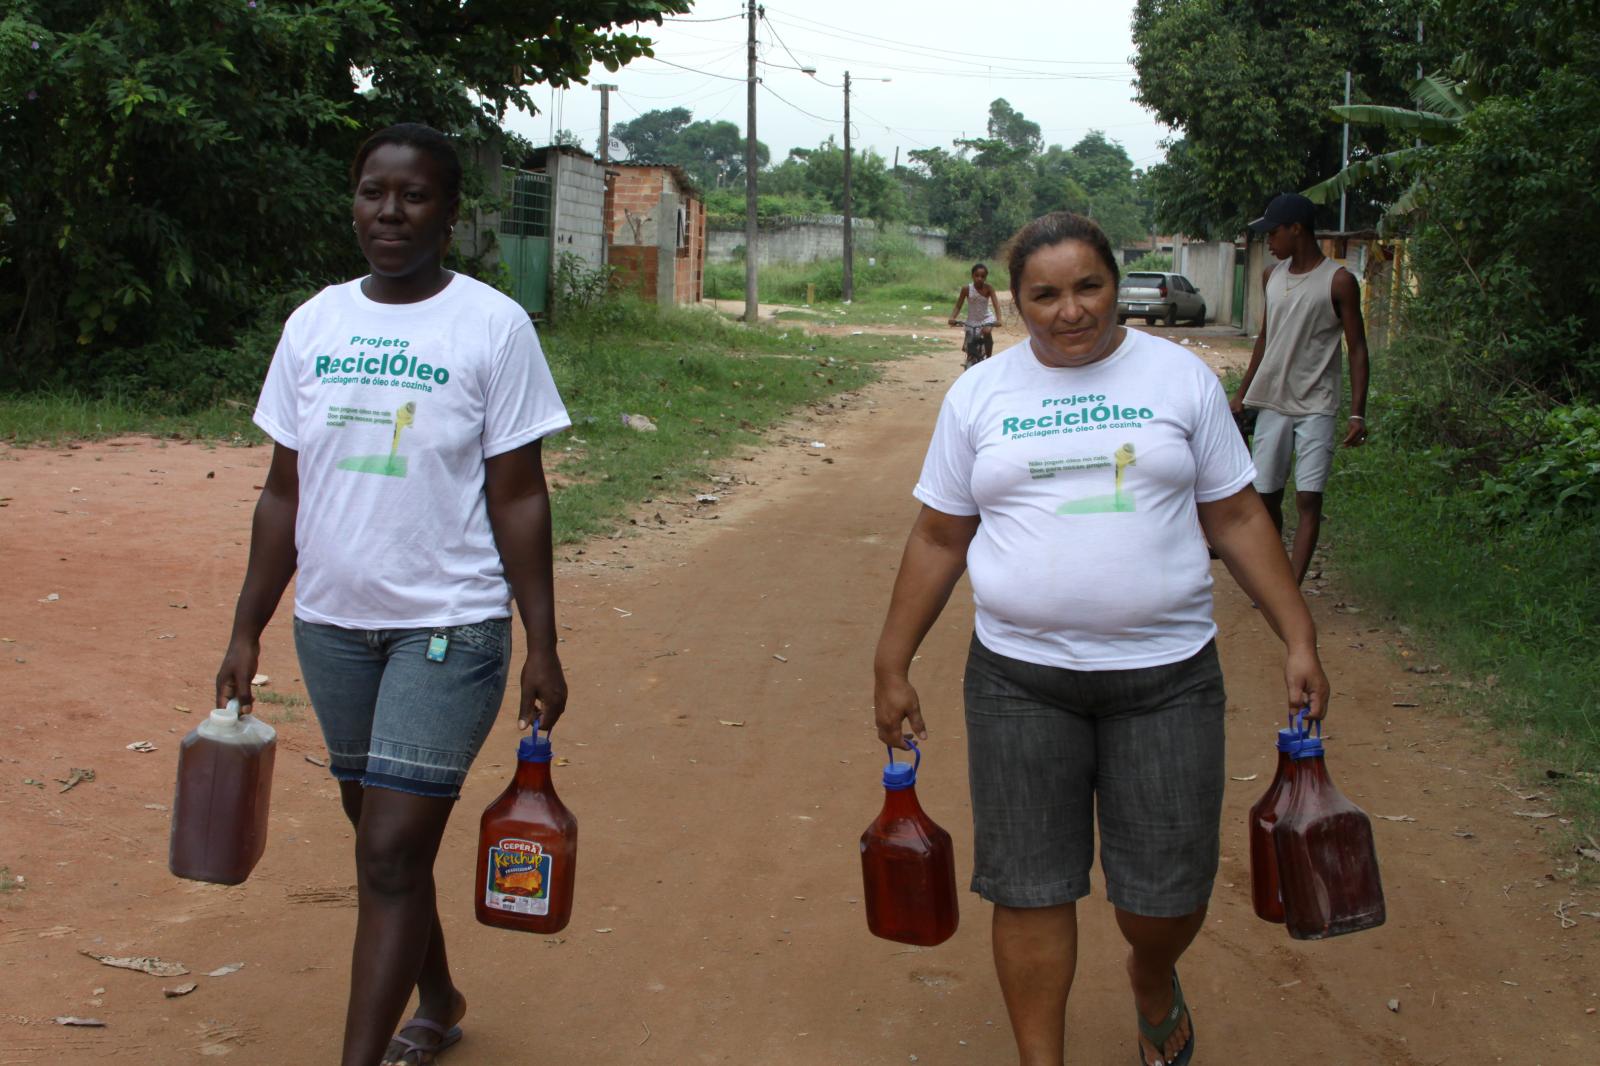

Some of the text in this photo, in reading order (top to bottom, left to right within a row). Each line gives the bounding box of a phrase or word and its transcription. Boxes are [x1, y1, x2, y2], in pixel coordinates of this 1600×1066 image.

[350, 336, 410, 348] Projeto
[315, 349, 450, 385] ReciclÓleo
[321, 375, 433, 393] Reciclagem de óleo de cozinha
[1042, 394, 1106, 408] Projeto
[1002, 402, 1154, 436] ReciclÓleo
[1011, 420, 1142, 441] Reciclagem de óleo de cozinha
[495, 851, 543, 868] Ketchup
